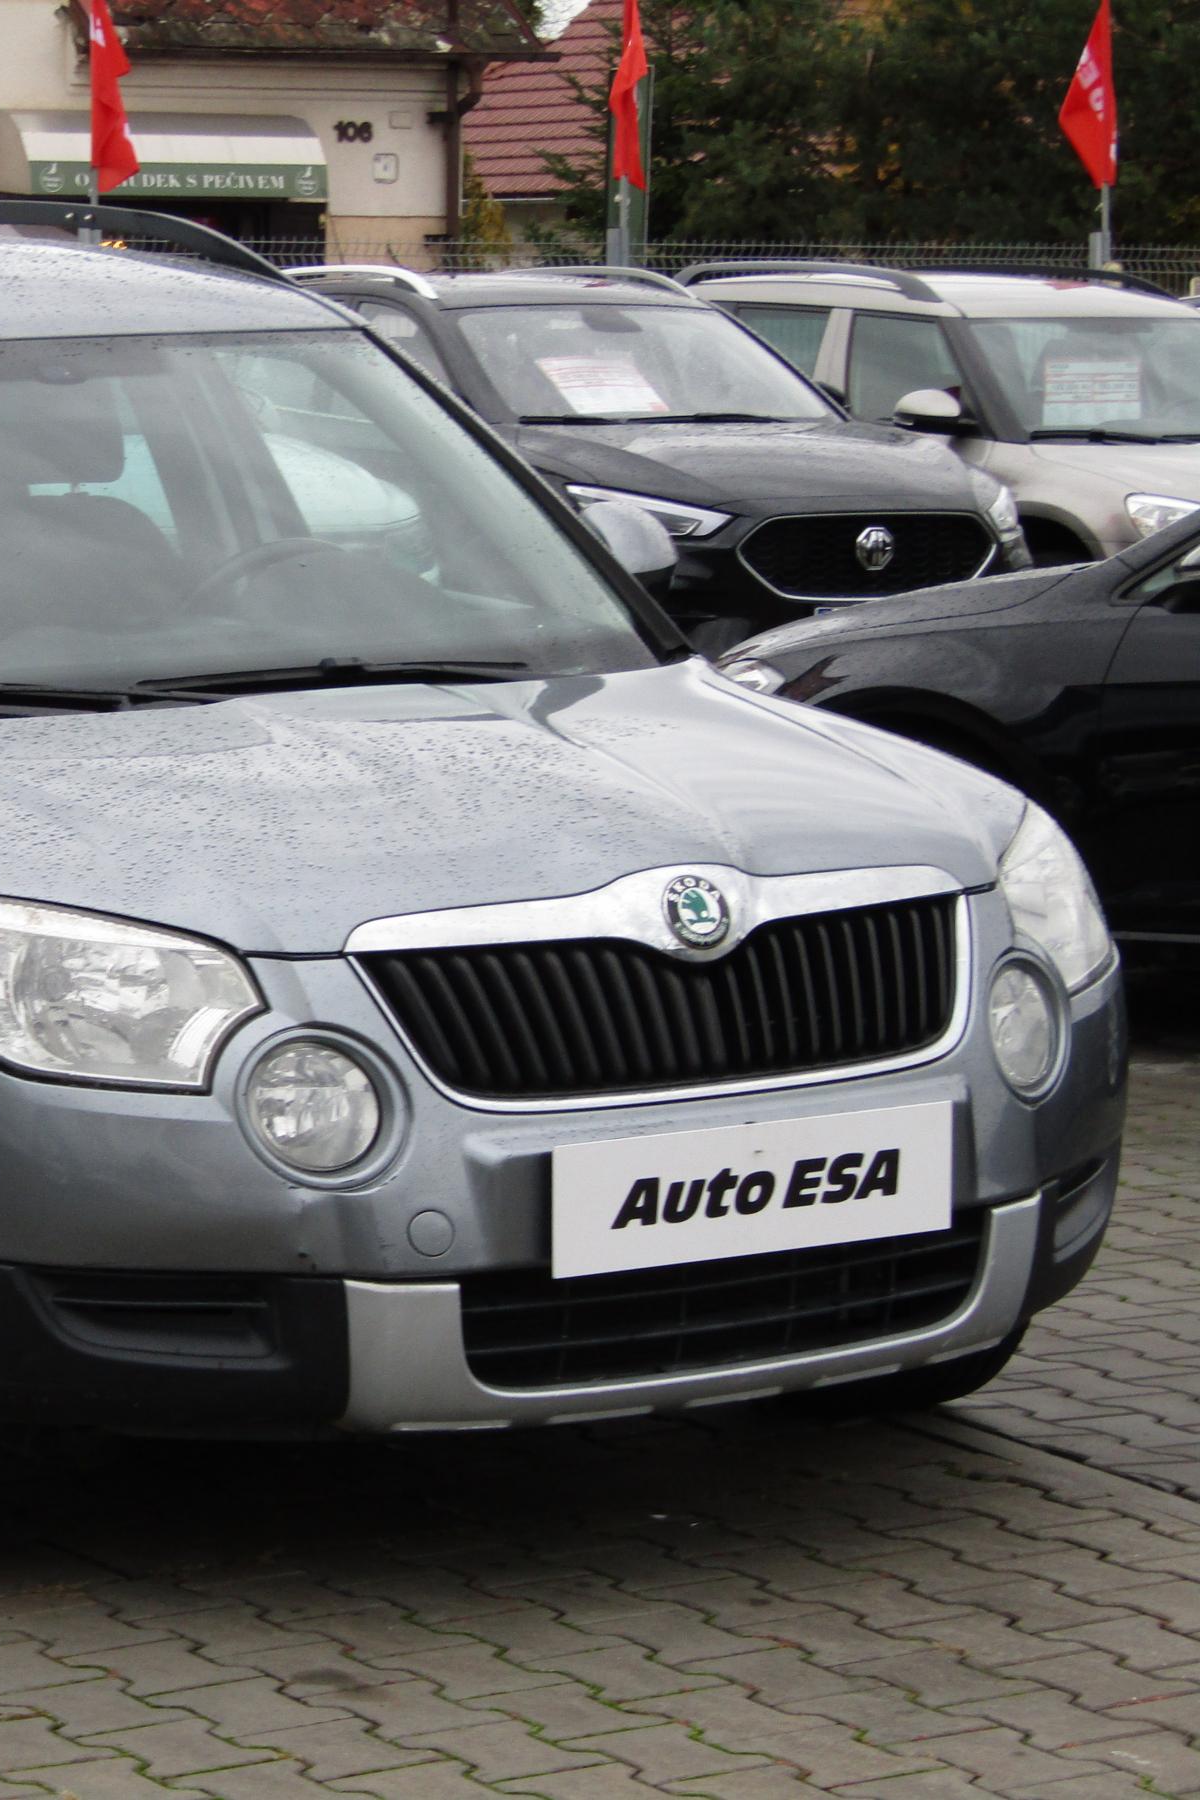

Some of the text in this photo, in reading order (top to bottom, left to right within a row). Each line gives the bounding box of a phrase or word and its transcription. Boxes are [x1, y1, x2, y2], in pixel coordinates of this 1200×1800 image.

[333, 121, 373, 143] 106
[186, 174, 198, 189] S
[202, 171, 285, 190] PEČIVEM
[611, 1148, 900, 1229] Auto ESA
